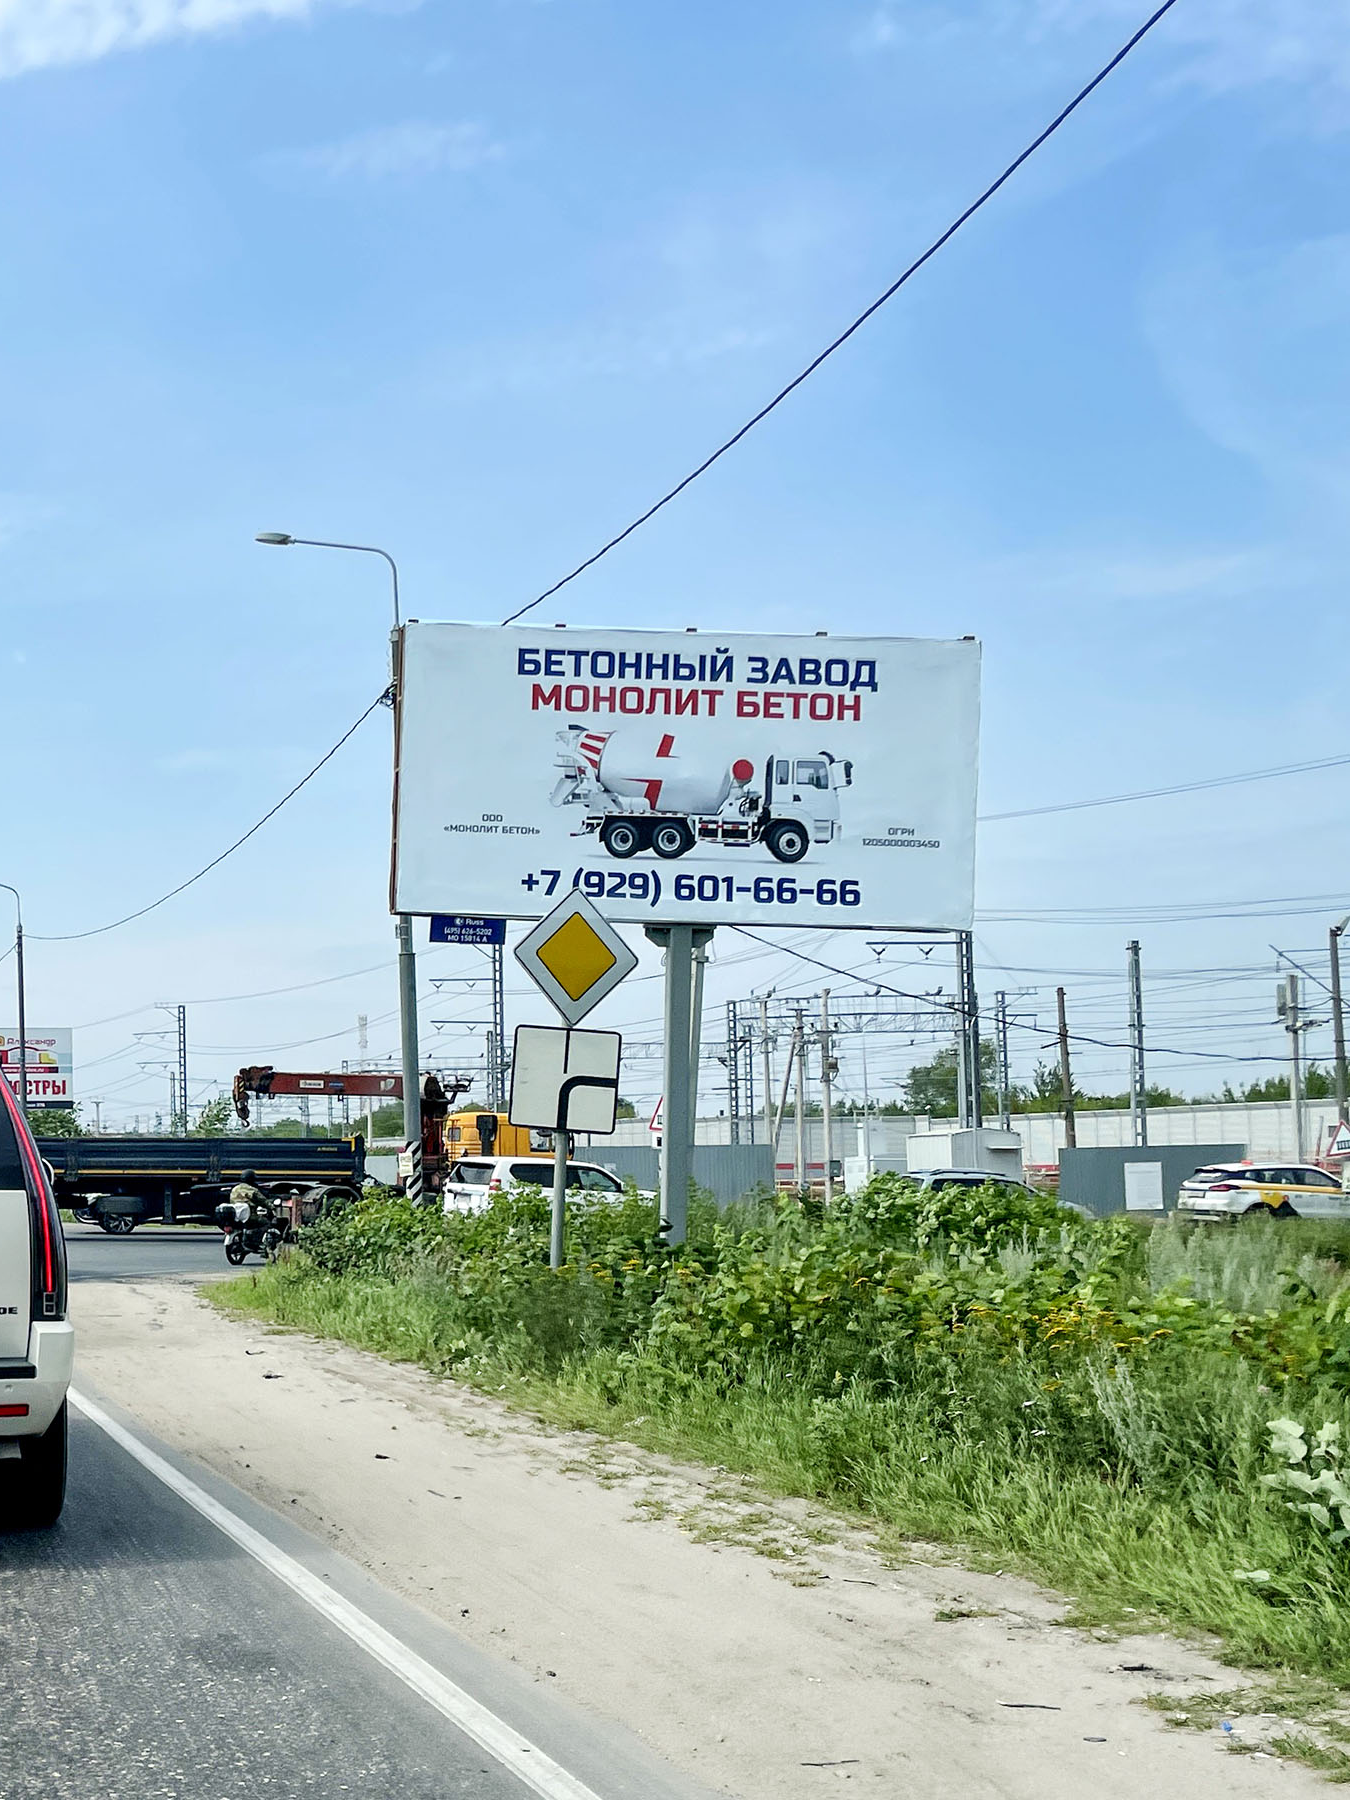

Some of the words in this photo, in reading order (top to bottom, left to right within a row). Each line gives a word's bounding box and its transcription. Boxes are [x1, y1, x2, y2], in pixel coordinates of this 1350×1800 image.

[517, 647, 733, 683] БЕТОННЫЙ
[746, 656, 878, 692] ЗАВОД
[531, 684, 724, 716] МОНОЛИТ
[736, 690, 861, 721] БЕТОН
[481, 813, 503, 822] ООО
[443, 824, 499, 834] «МОНОЛИТ
[502, 825, 540, 835] БЕТОН»
[888, 827, 915, 836] ОГРН
[521, 869, 561, 896] +7
[572, 867, 662, 908] (929)
[674, 873, 861, 906] 601-66-66
[465, 918, 484, 926] Russ
[7, 1038, 56, 1047] Алксандр
[8, 1080, 66, 1095] ЮСТРЫ
